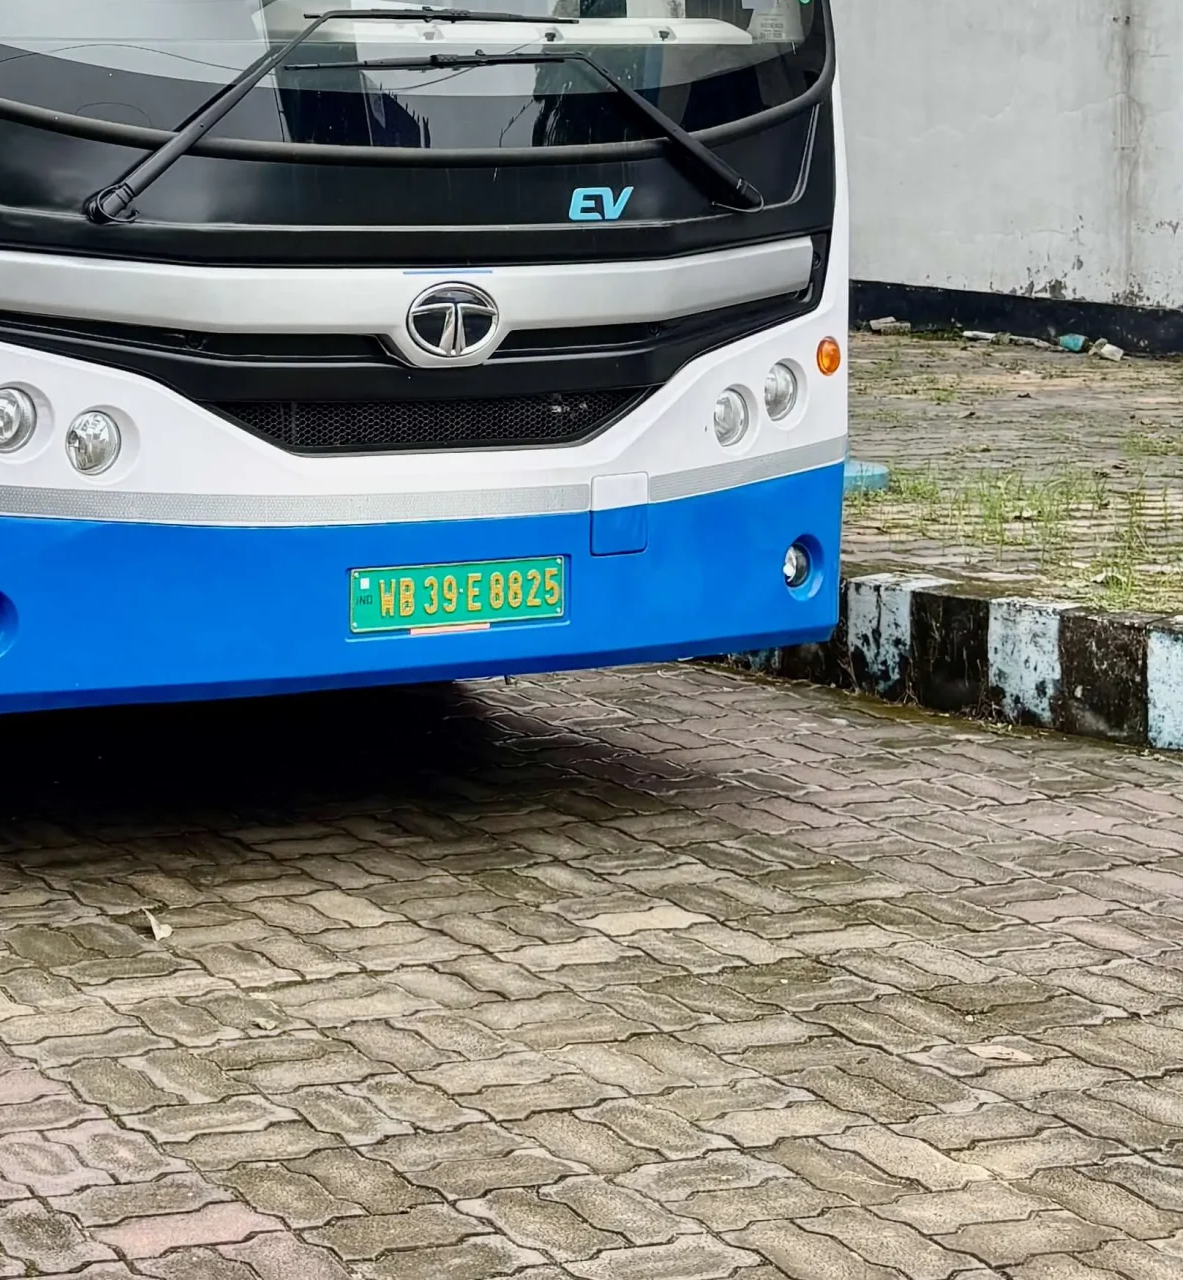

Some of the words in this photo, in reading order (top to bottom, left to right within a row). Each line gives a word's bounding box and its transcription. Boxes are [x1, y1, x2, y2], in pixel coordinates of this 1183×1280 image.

[568, 186, 635, 220] EV
[379, 577, 415, 617] WB
[423, 575, 458, 614] 39
[467, 572, 482, 612] E
[489, 567, 561, 609] 8825
